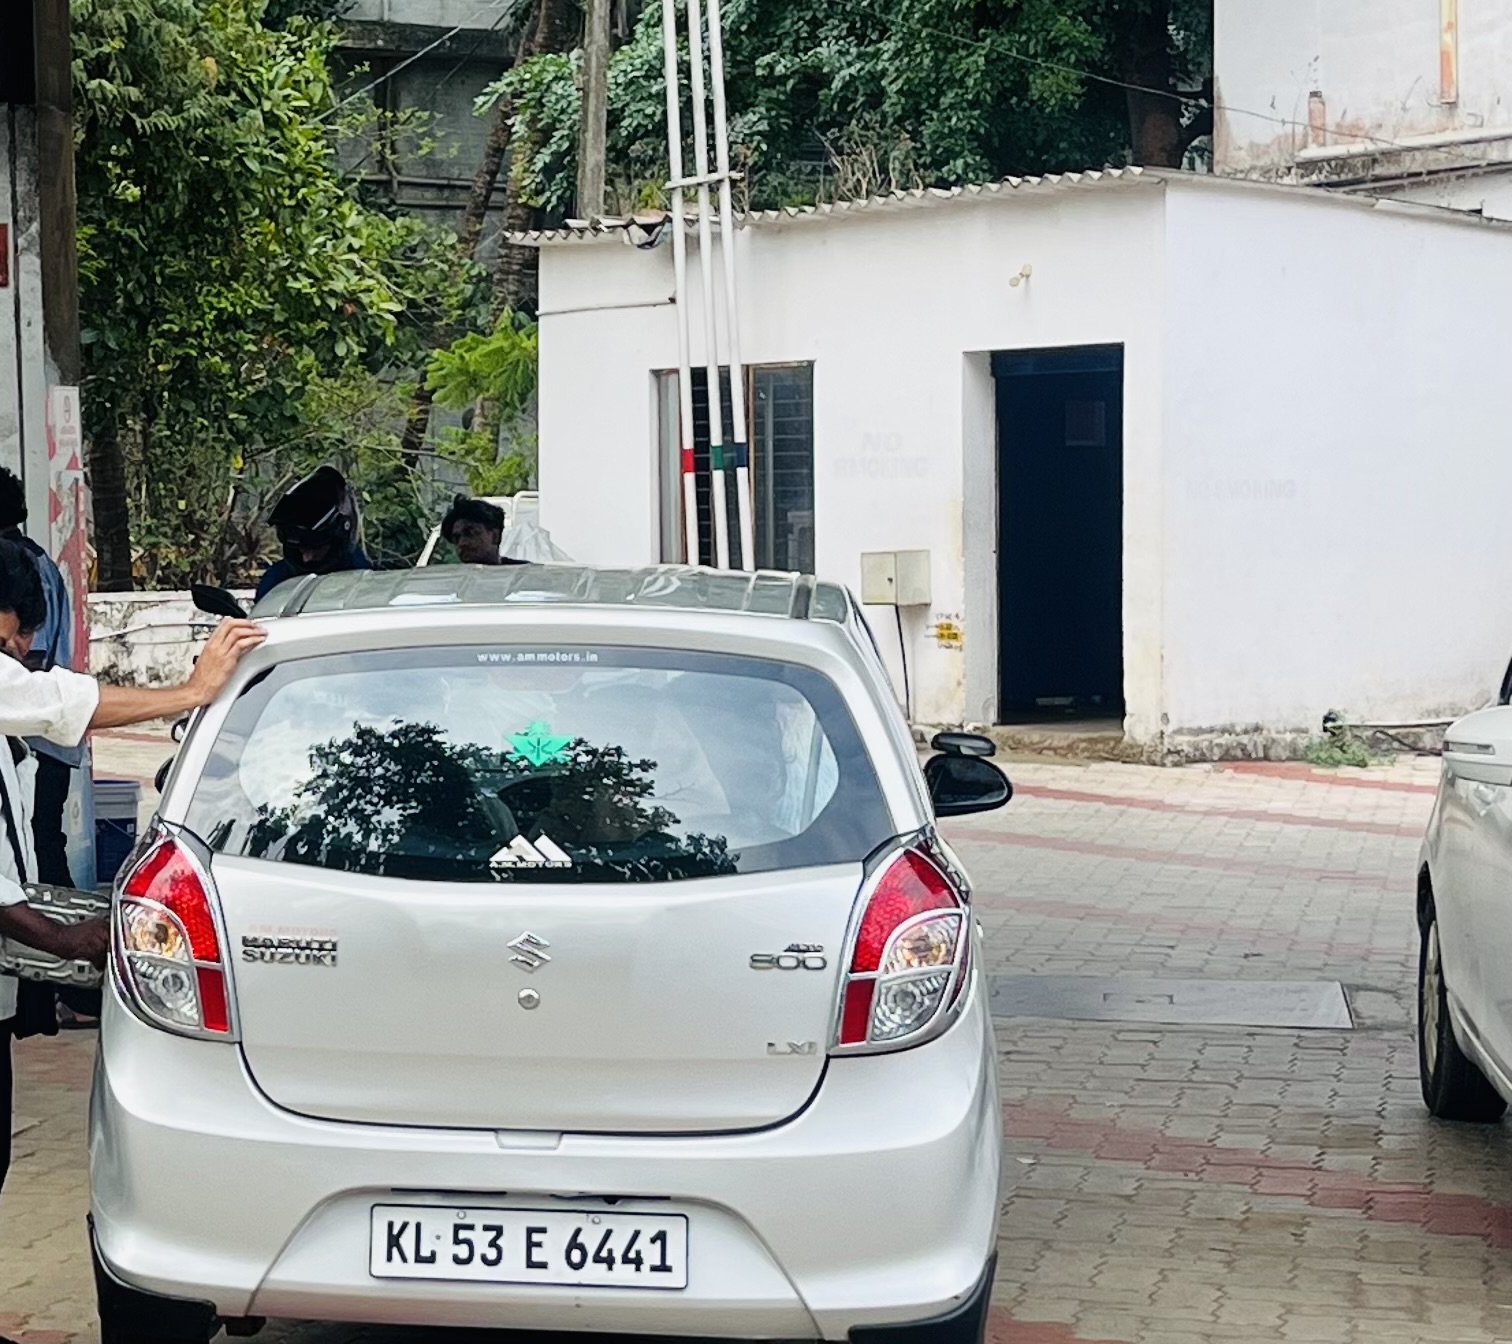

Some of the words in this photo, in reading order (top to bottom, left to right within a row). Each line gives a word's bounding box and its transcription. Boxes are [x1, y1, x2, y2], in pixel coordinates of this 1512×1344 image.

[477, 651, 599, 662] www.ammotors.in
[241, 935, 338, 952] MARUTI
[241, 948, 338, 967] SUZUKI
[749, 953, 828, 971] 800
[386, 1220, 437, 1265] KL
[451, 1223, 504, 1267] 53
[525, 1226, 549, 1269] E
[564, 1227, 674, 1273] 6441
